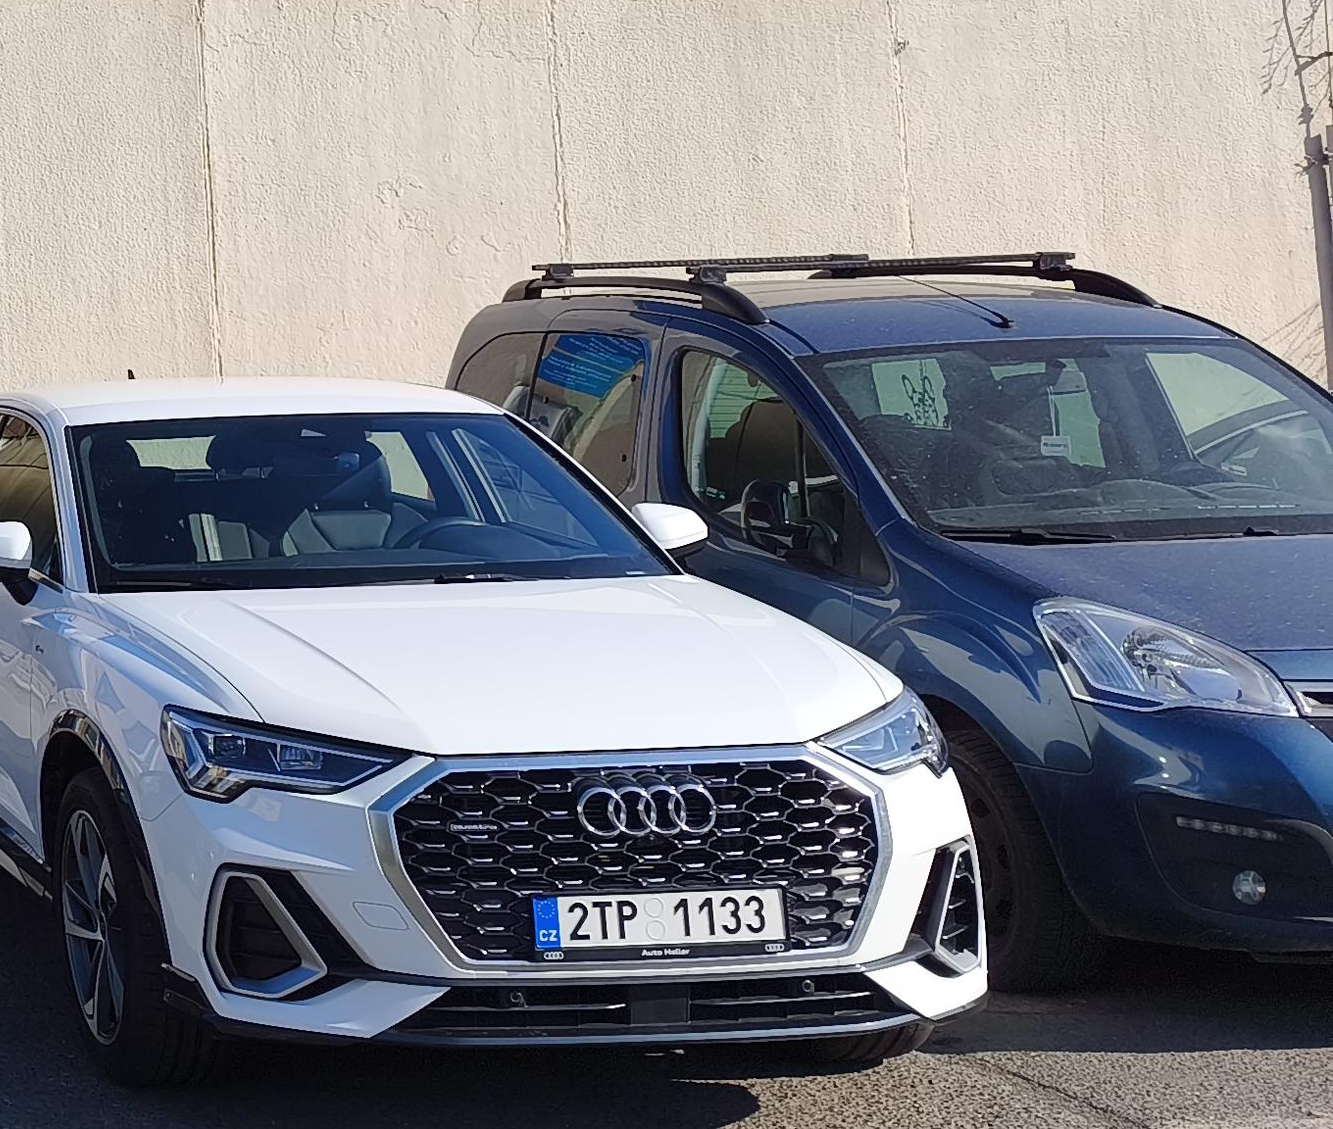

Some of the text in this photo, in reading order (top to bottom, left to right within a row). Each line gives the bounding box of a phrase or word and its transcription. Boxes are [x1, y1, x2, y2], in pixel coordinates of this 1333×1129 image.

[567, 895, 766, 941] 2TP 1133
[539, 929, 558, 942] CZ
[641, 948, 663, 957] Auto
